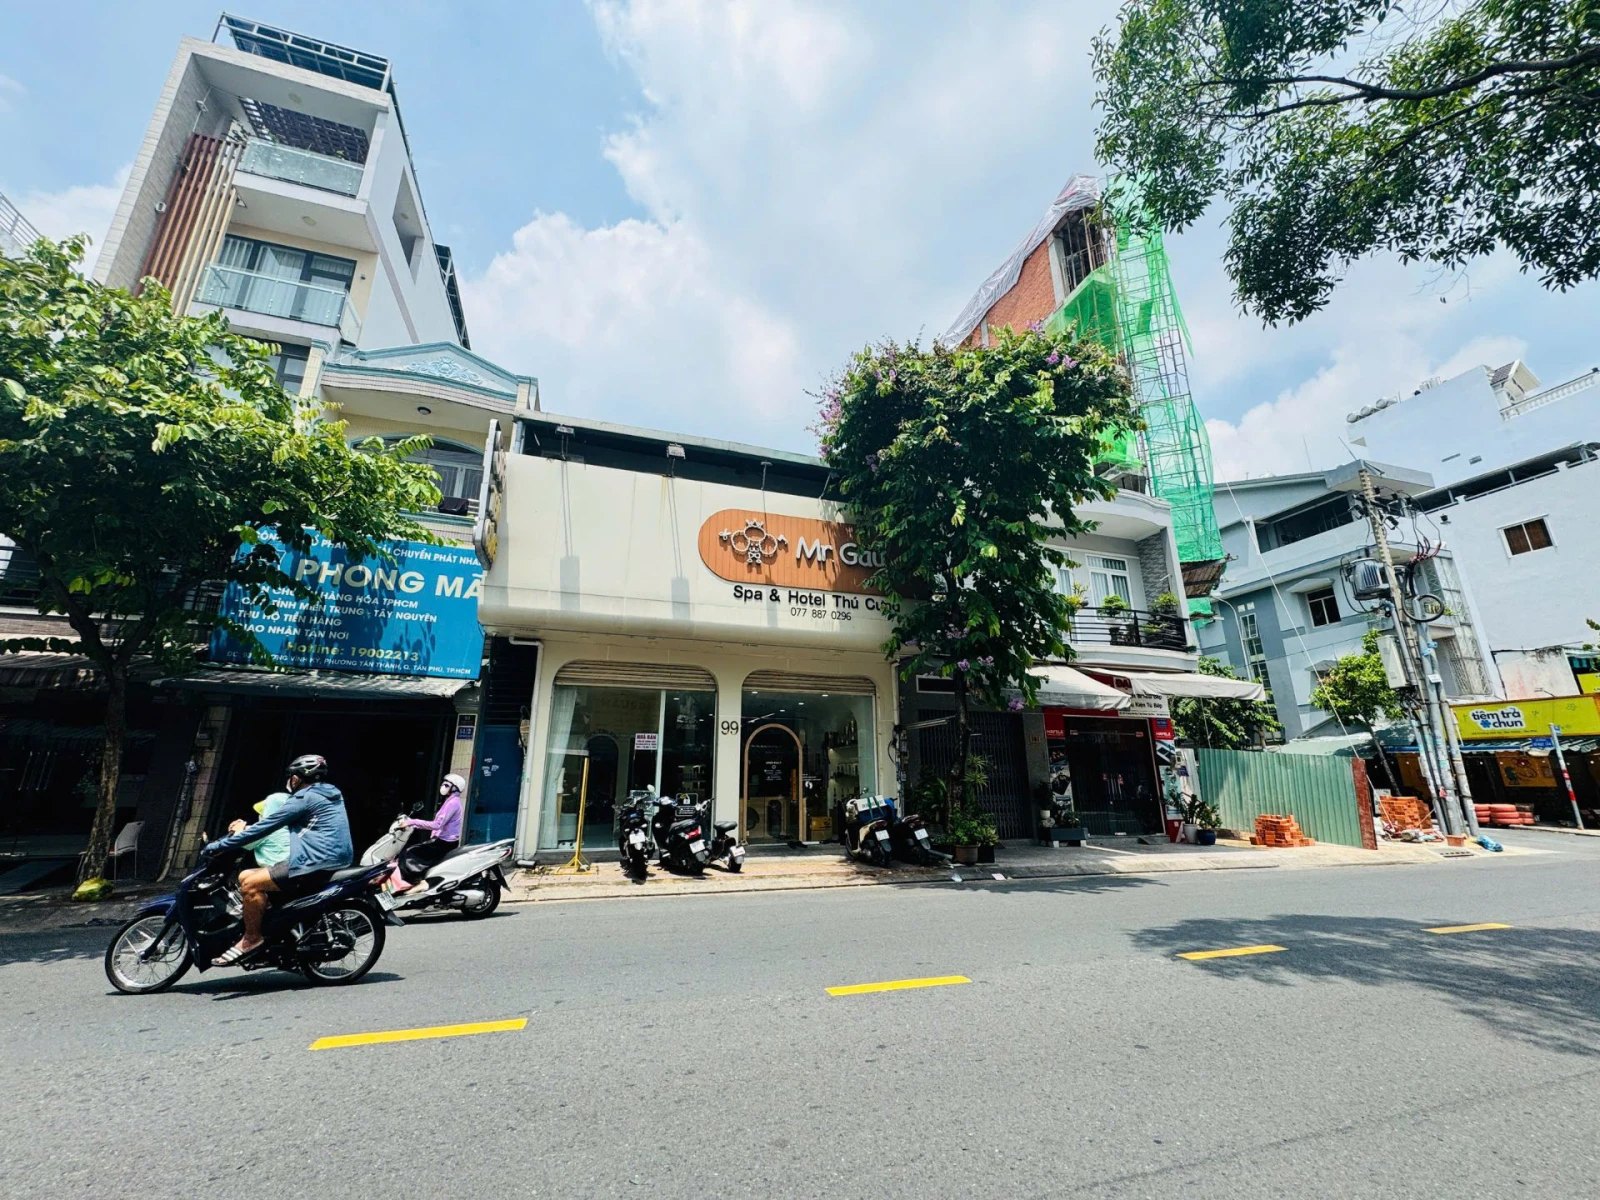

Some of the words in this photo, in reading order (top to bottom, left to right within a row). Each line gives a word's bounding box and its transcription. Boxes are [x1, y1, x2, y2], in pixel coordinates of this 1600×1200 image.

[393, 547, 431, 561] CHUYỂN
[433, 552, 457, 563] PHÁT
[459, 556, 481, 567] NHA
[796, 536, 835, 564] Mr.
[295, 559, 425, 594] PHONG
[320, 592, 352, 602] HÀNG
[382, 597, 418, 609] TPHCM
[733, 585, 763, 603] Spa
[769, 588, 781, 602] &
[788, 590, 826, 608] Hotel
[832, 594, 859, 610] Thú
[238, 609, 260, 619] THU
[309, 616, 342, 627] HÀNG
[329, 605, 365, 616] TRUNG
[373, 608, 393, 619] TÂY
[395, 612, 438, 623] NGUYÊN
[790, 606, 807, 617] 077
[811, 609, 827, 619] 887
[831, 611, 852, 621] 0296
[286, 642, 345, 656] Hotline:
[350, 647, 419, 661] 19002213
[721, 720, 739, 735] 99
[1492, 712, 1524, 728] chun
